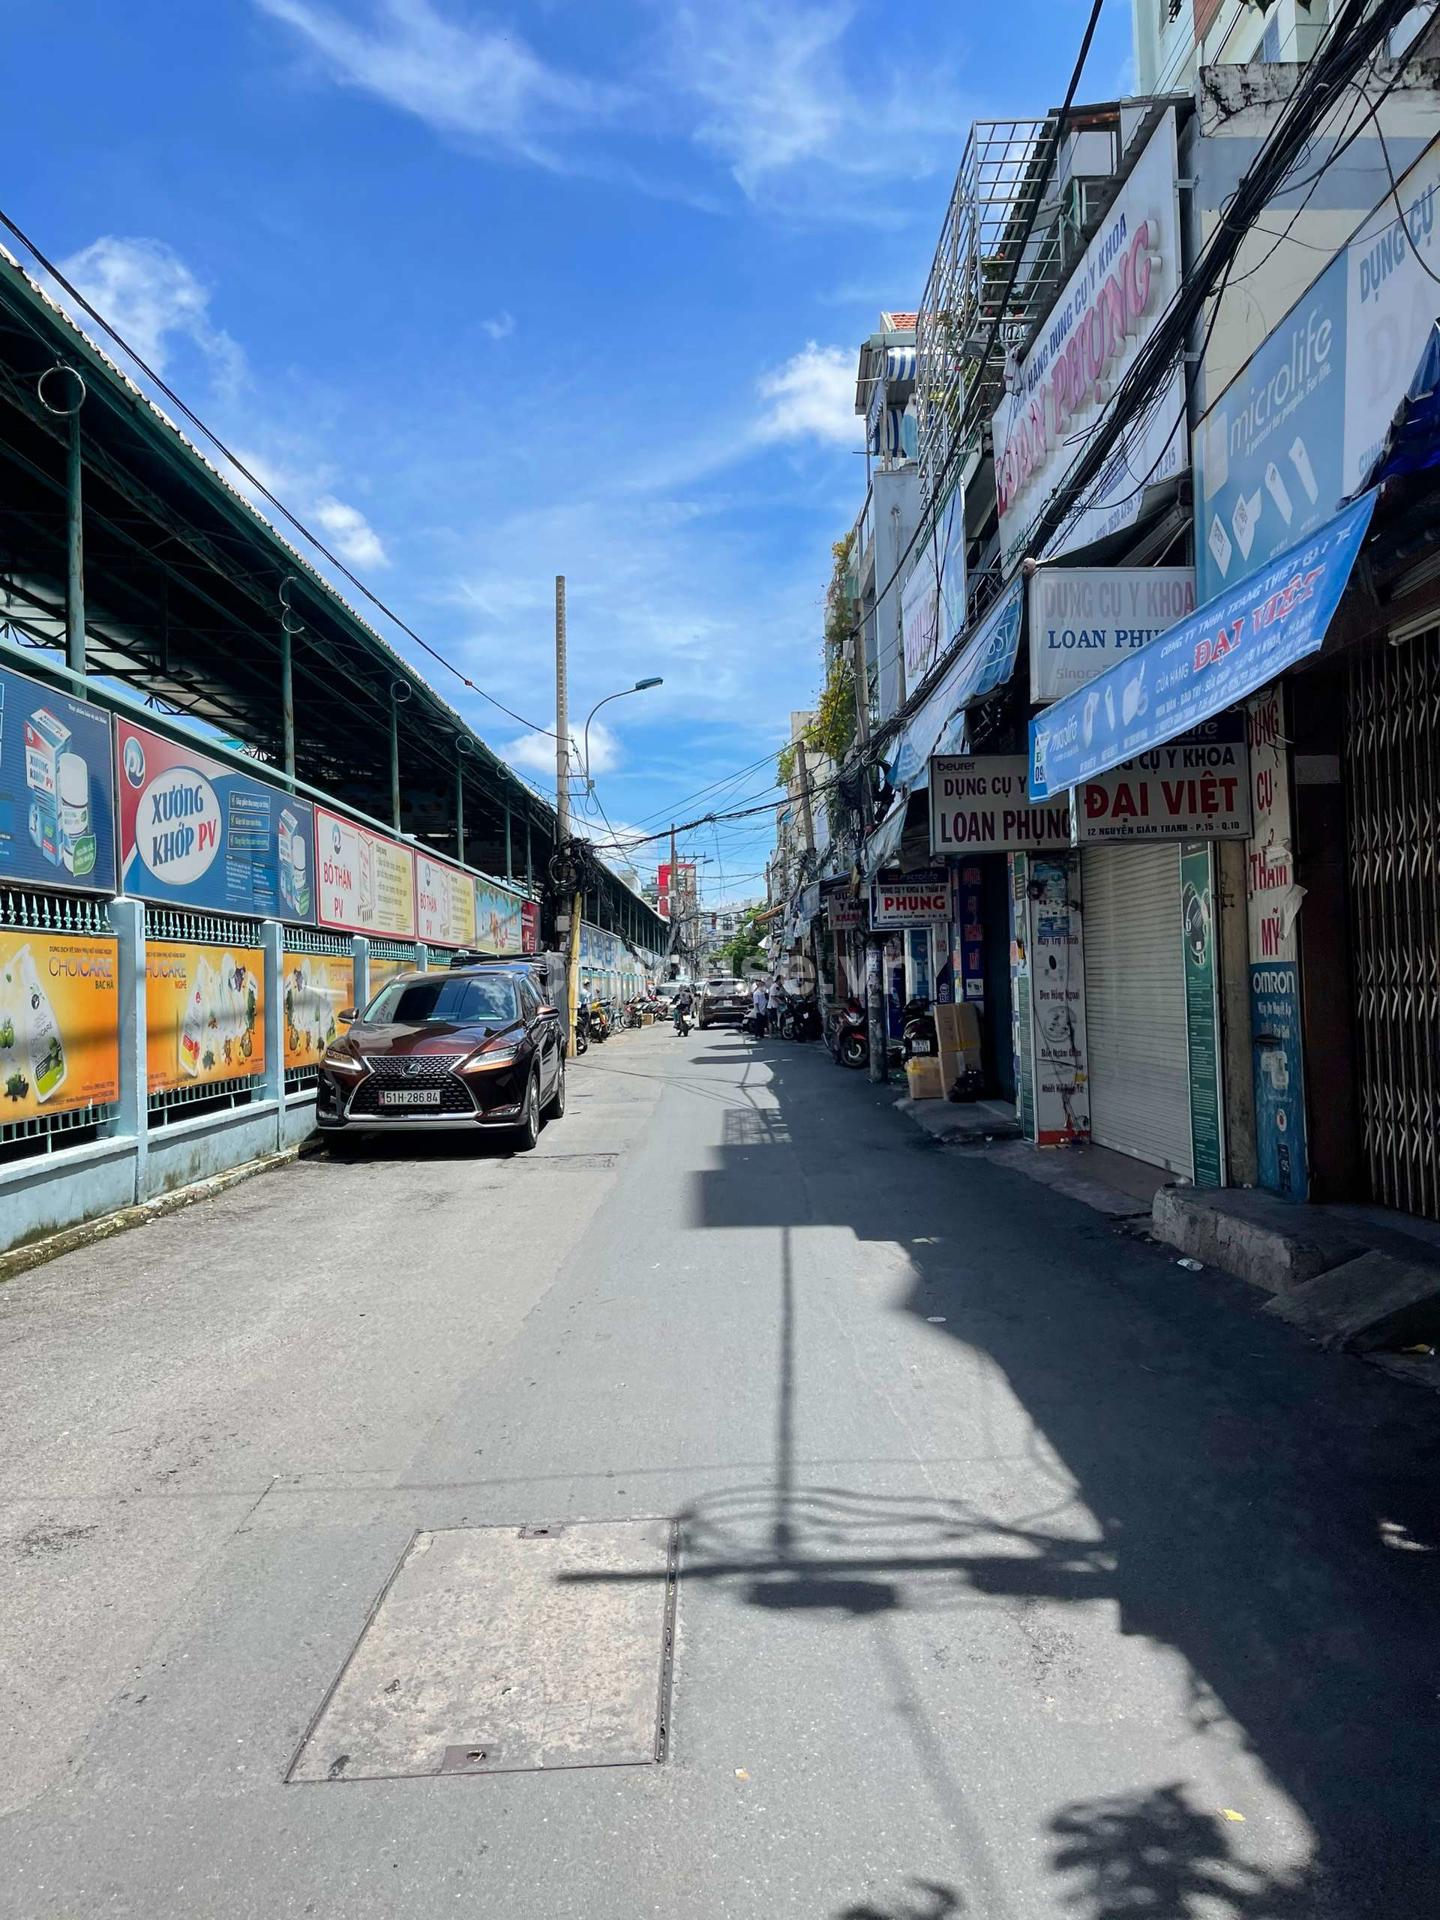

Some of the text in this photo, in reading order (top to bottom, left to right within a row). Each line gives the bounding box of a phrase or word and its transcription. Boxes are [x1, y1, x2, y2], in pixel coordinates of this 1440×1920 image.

[1360, 221, 1406, 304] DỤNG
[1050, 302, 1074, 357] DỤNG
[1075, 277, 1088, 316] CỤ
[1089, 261, 1097, 290] Y
[1099, 212, 1128, 275] KHOA
[1230, 304, 1332, 457] microlife
[1128, 581, 1140, 618] Y
[1146, 580, 1195, 618] KHOA
[1048, 629, 1107, 649] LOAN
[937, 761, 976, 772] beurer
[1140, 748, 1161, 775] CỤ
[1166, 749, 1178, 769] Y
[1183, 746, 1236, 768] KHOA
[152, 784, 204, 825] XƯƠNG
[944, 777, 987, 800] DỤNG
[991, 776, 1012, 798] CỤ
[1084, 769, 1239, 823] ĐẠI VIỆT
[1256, 768, 1273, 816] CỤ
[152, 822, 194, 867] KHỚP
[197, 819, 217, 852] PV
[941, 811, 996, 843] LOAN
[1160, 823, 1189, 834] THANH
[1195, 821, 1214, 833] P.15
[333, 896, 344, 919] PV
[884, 895, 946, 915] PHỤNG
